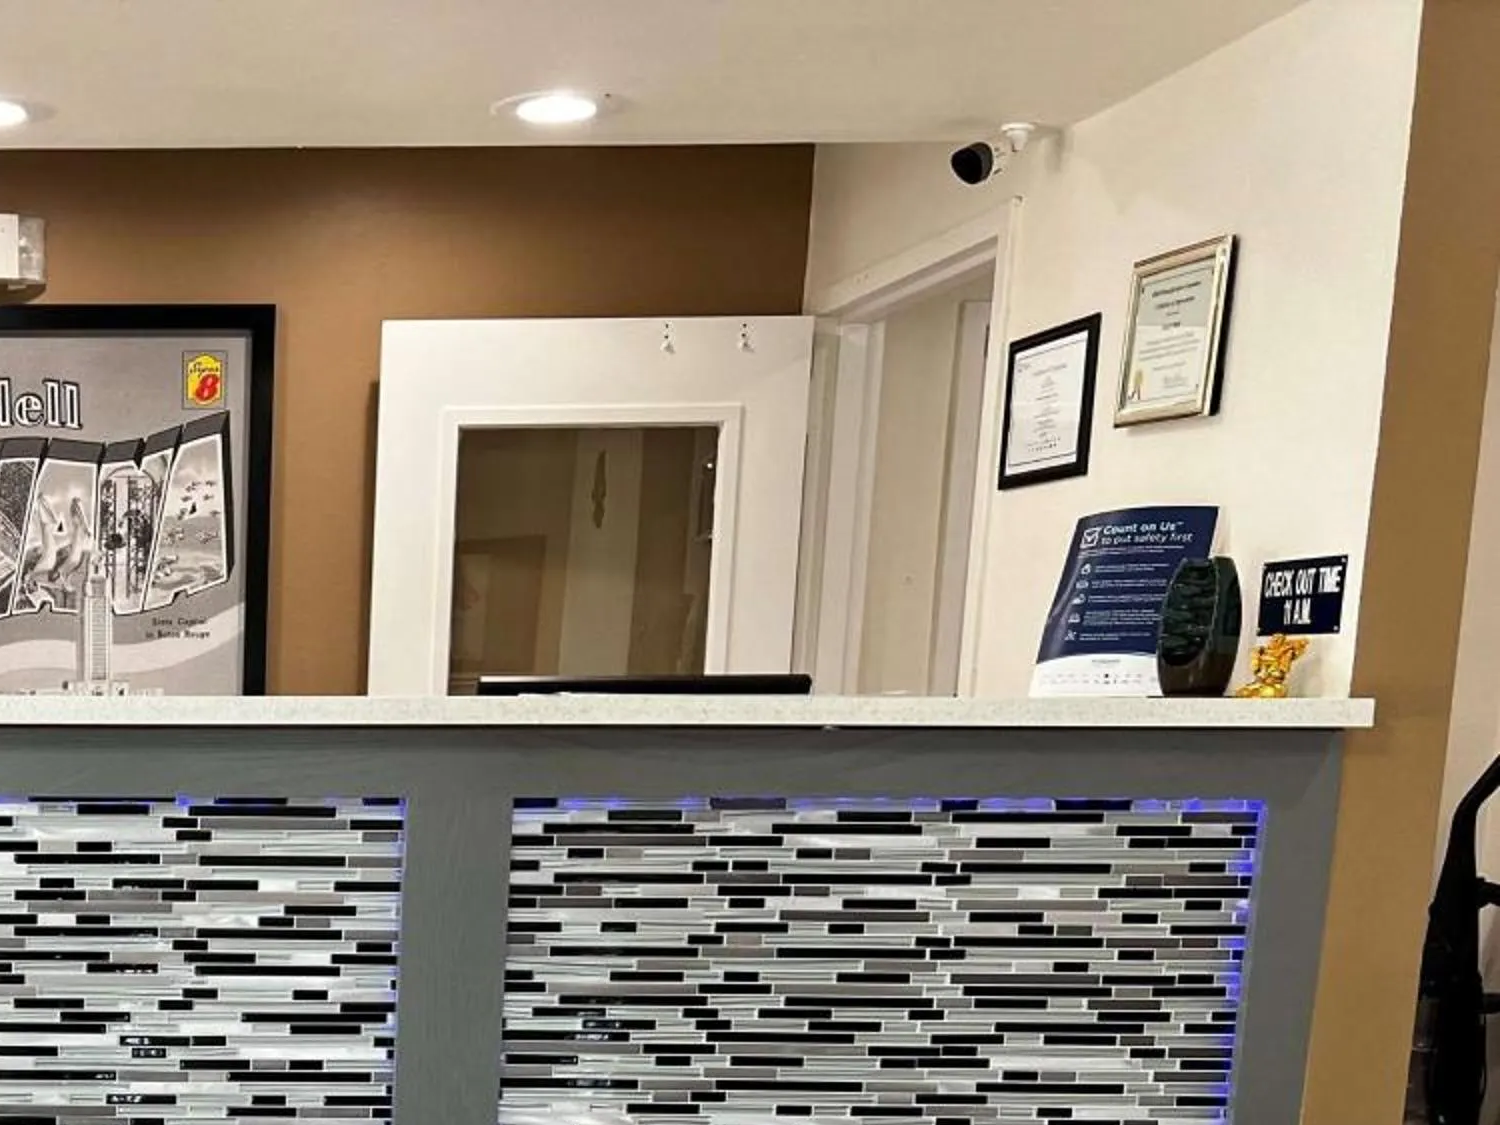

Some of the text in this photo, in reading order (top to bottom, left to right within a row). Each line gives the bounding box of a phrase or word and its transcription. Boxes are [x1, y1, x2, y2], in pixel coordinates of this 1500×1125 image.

[195, 373, 220, 402] 8
[1101, 532, 1193, 545] to put safety first
[1103, 524, 1137, 535] Count
[1140, 523, 1157, 532] on
[1264, 565, 1343, 598] CHECK OUT TIME
